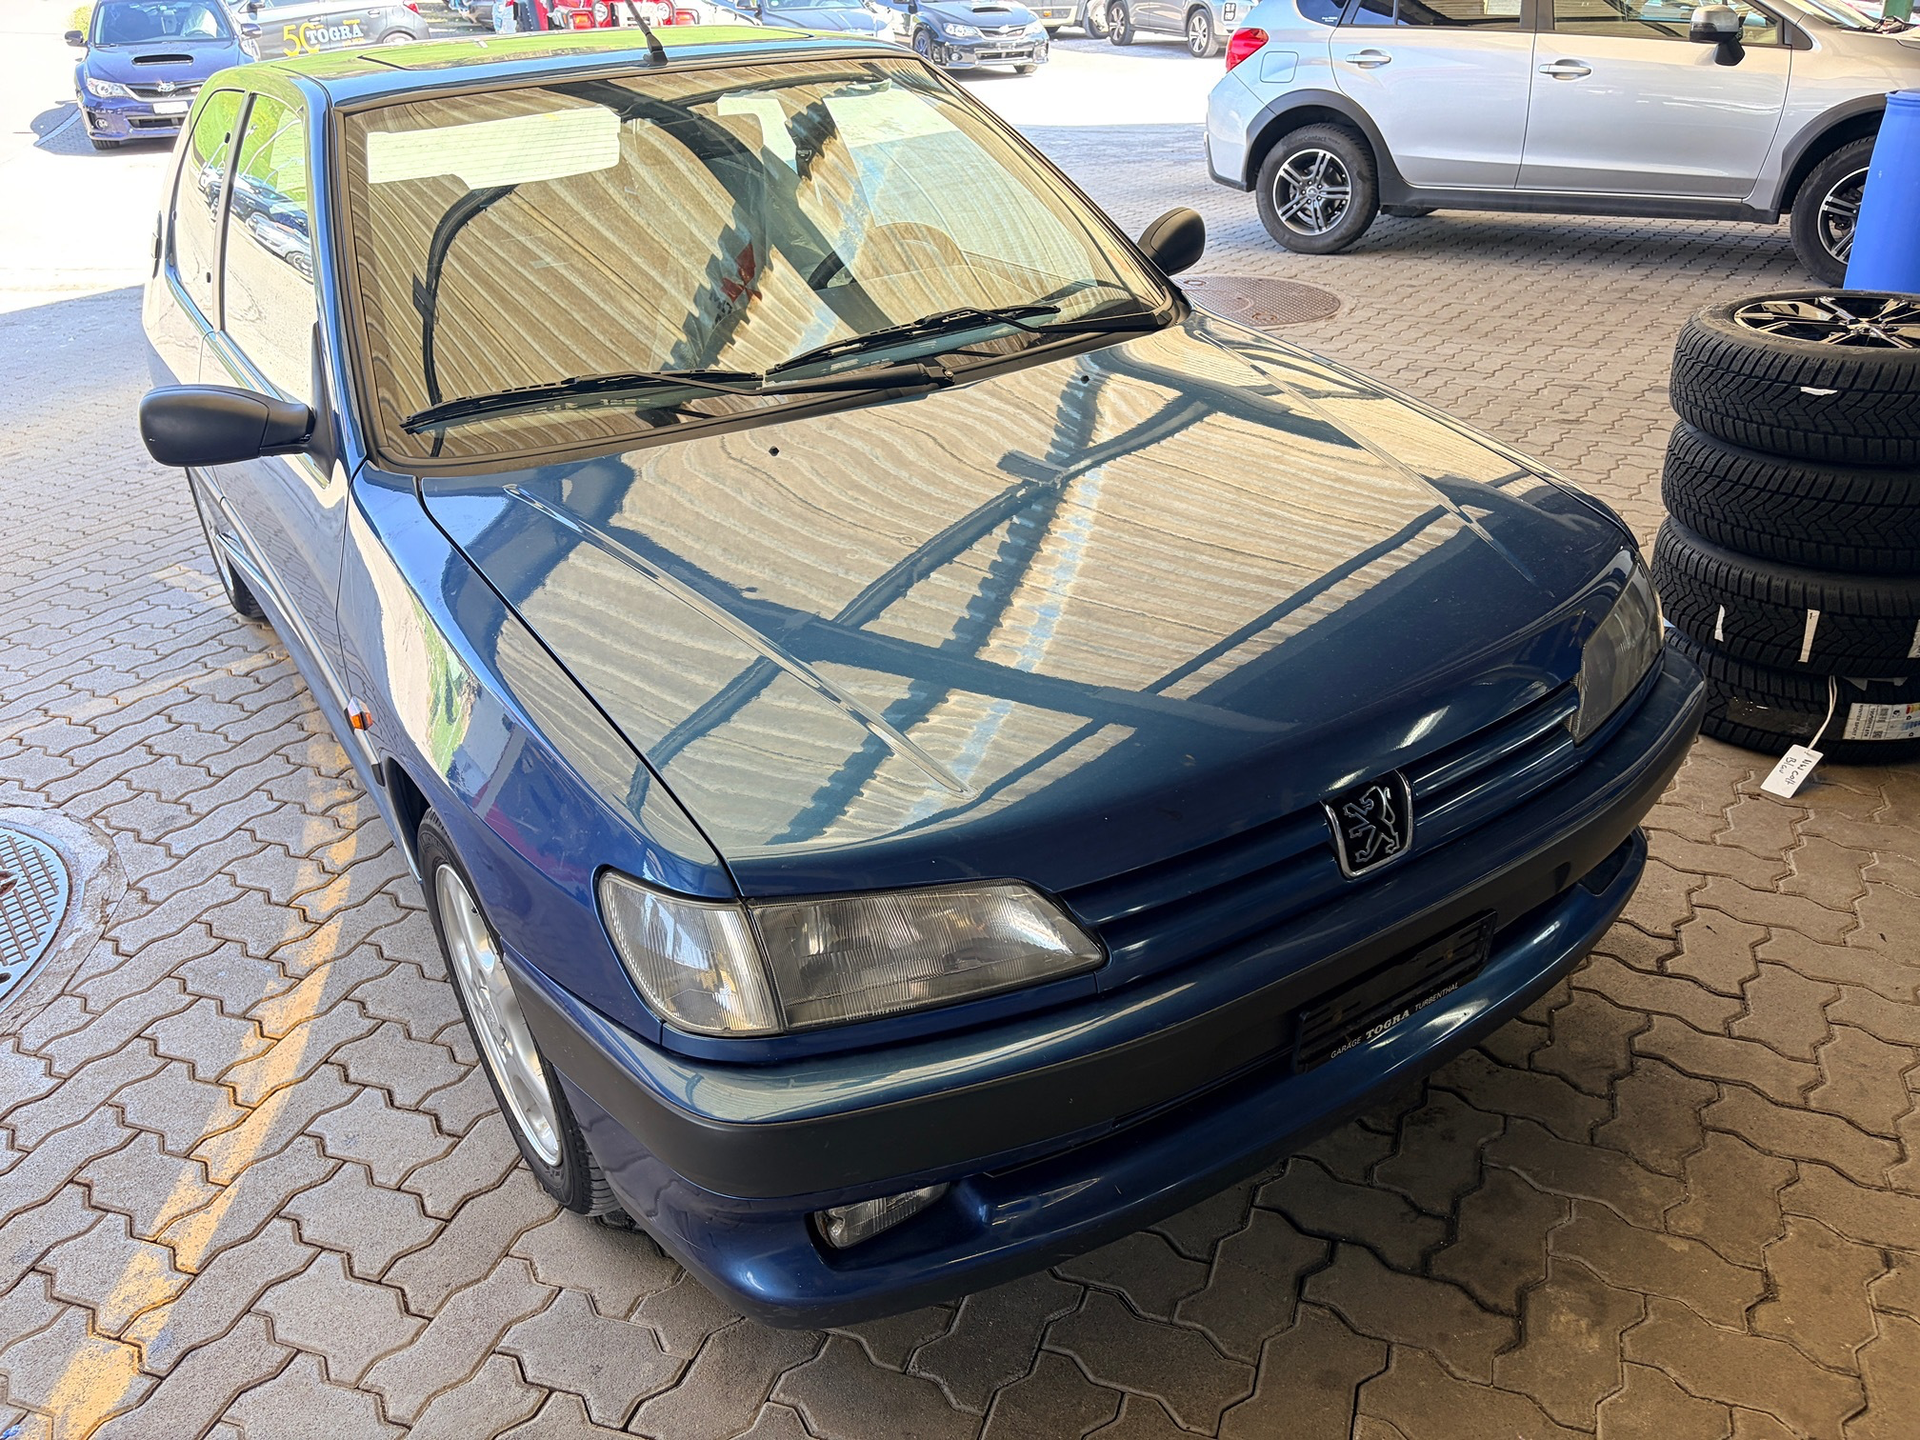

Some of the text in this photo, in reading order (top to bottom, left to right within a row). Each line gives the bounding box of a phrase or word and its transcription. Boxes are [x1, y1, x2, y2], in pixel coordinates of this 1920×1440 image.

[305, 24, 364, 45] TOGRA
[1330, 982, 1459, 1059] GARAGE TOGRA TURBENTHAL
